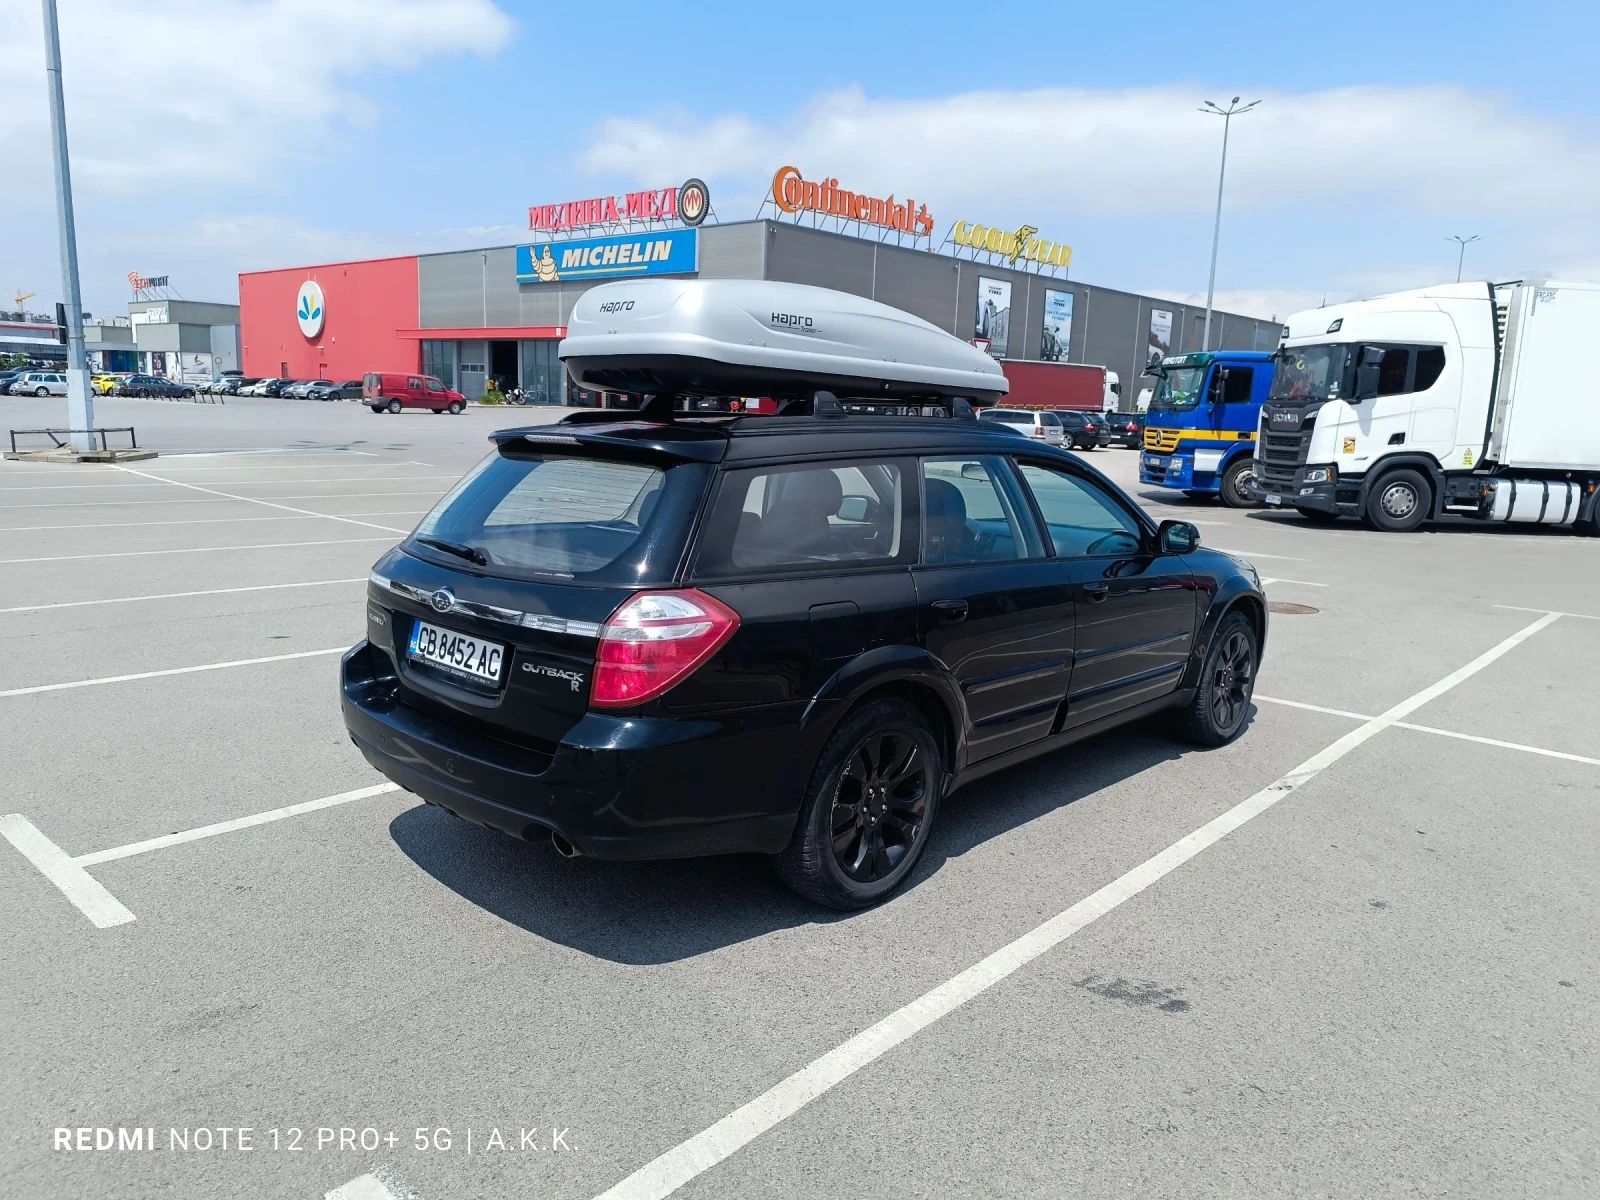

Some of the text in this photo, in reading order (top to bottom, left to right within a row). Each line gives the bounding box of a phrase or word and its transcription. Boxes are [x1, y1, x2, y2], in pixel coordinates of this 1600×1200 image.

[528, 187, 679, 232] МЕДИНА-МЕД
[773, 165, 916, 233] Continental
[561, 239, 673, 268] MICHELIN
[953, 219, 1073, 267] GOODYEAR
[599, 300, 636, 314] Hapro
[771, 312, 813, 327] Hapro
[1272, 413, 1299, 423] SCANIA
[418, 626, 437, 656] CB
[438, 633, 476, 669] 8452
[476, 645, 500, 677] AC
[522, 662, 584, 682] OUTBACK
[570, 680, 580, 692] R
